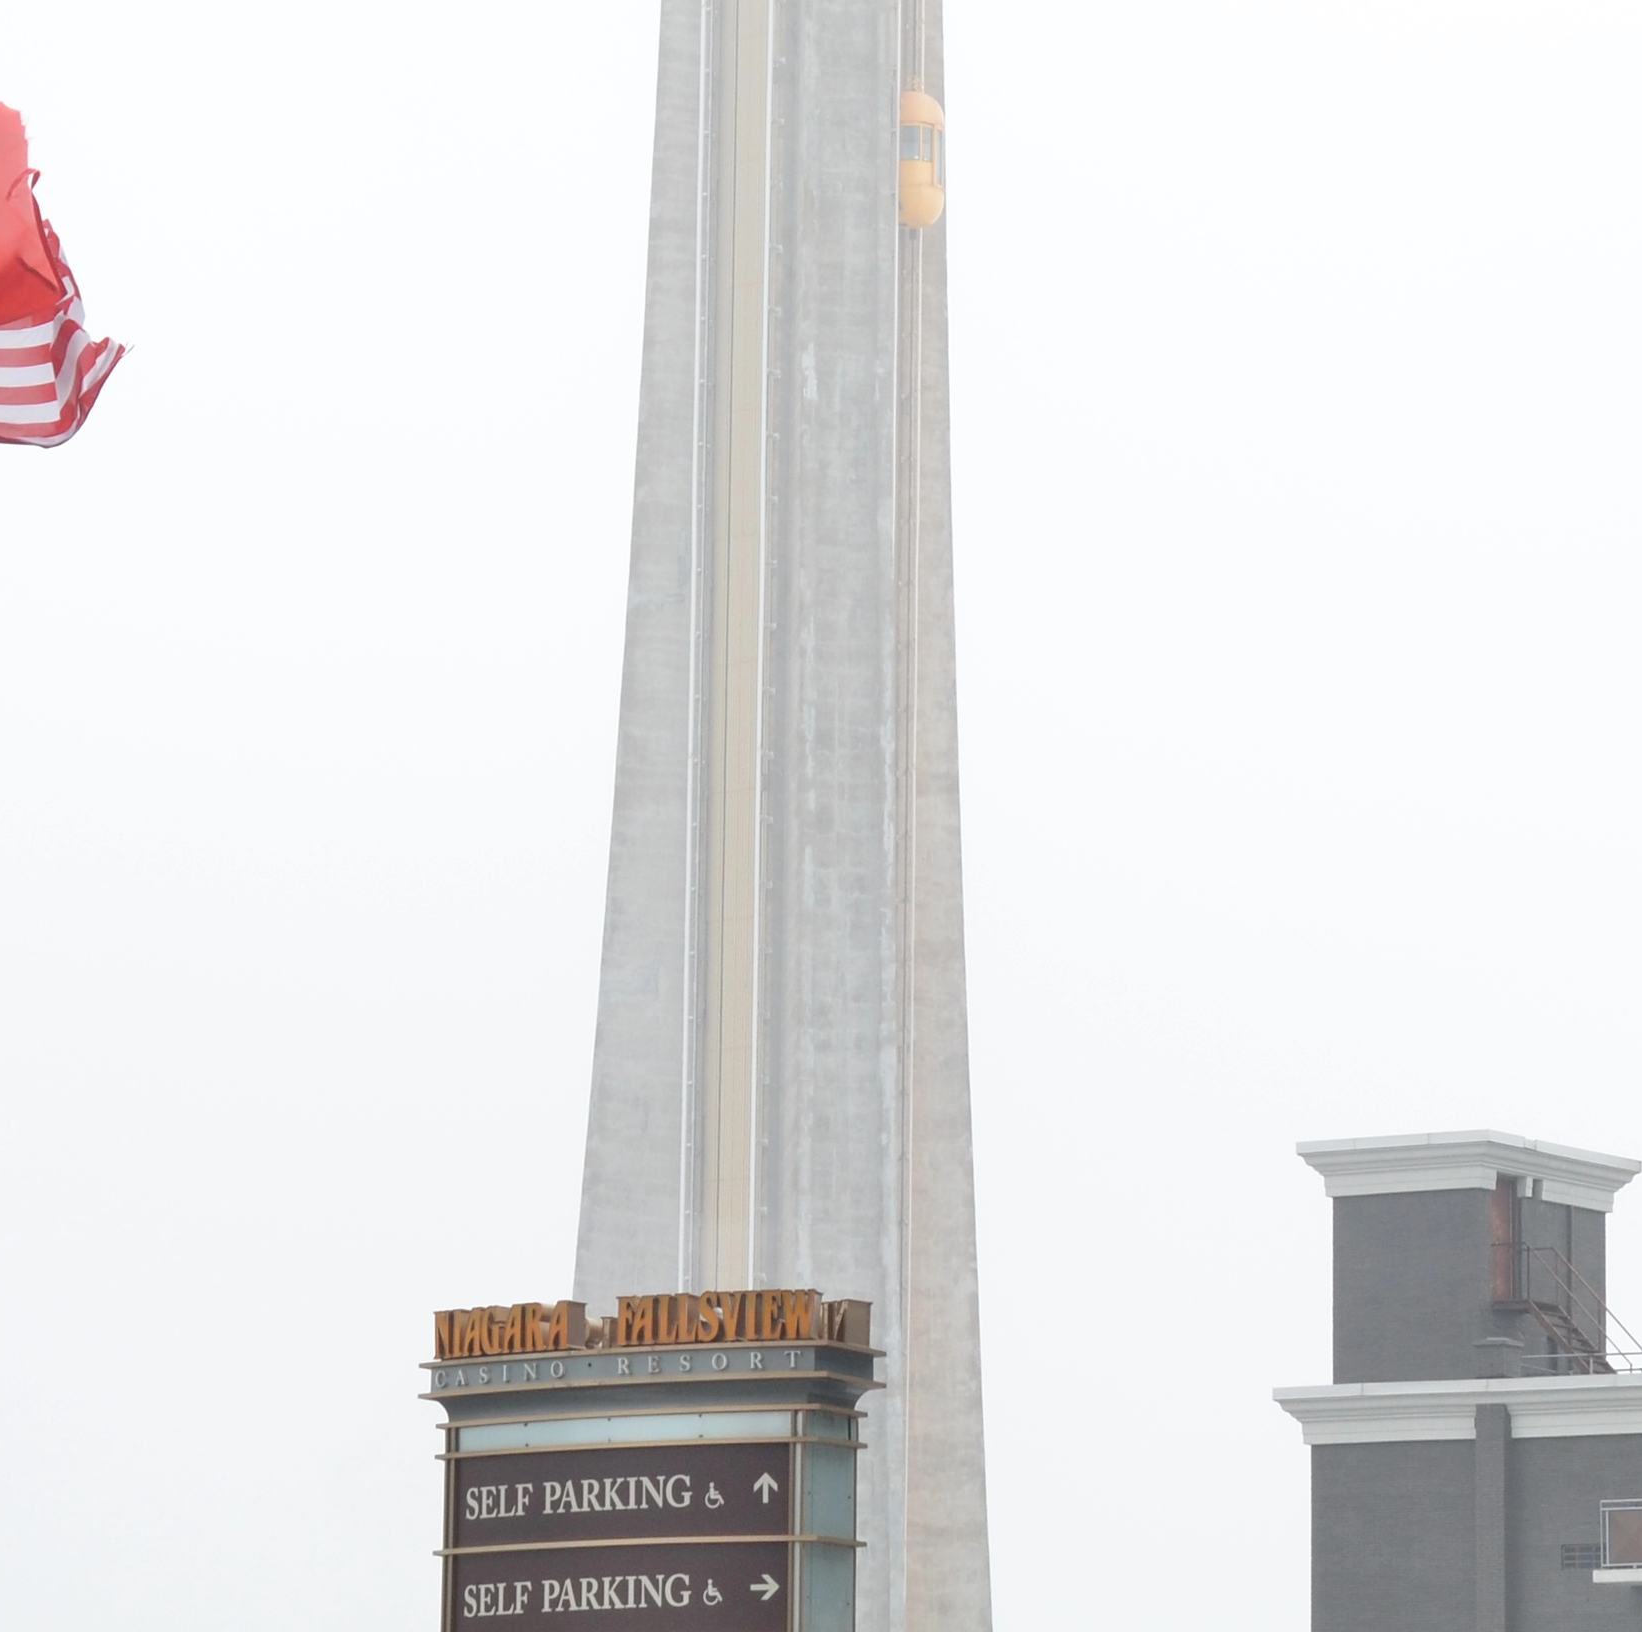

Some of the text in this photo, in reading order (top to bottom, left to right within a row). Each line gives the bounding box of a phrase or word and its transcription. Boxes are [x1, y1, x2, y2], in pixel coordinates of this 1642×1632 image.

[434, 1300, 568, 1359] NIAGARA
[617, 1289, 814, 1347] FALLSVIEW
[435, 1350, 801, 1387] CASINO RESORT
[465, 1474, 693, 1520] SELF PARKING
[463, 1573, 691, 1618] SELF PARKING
